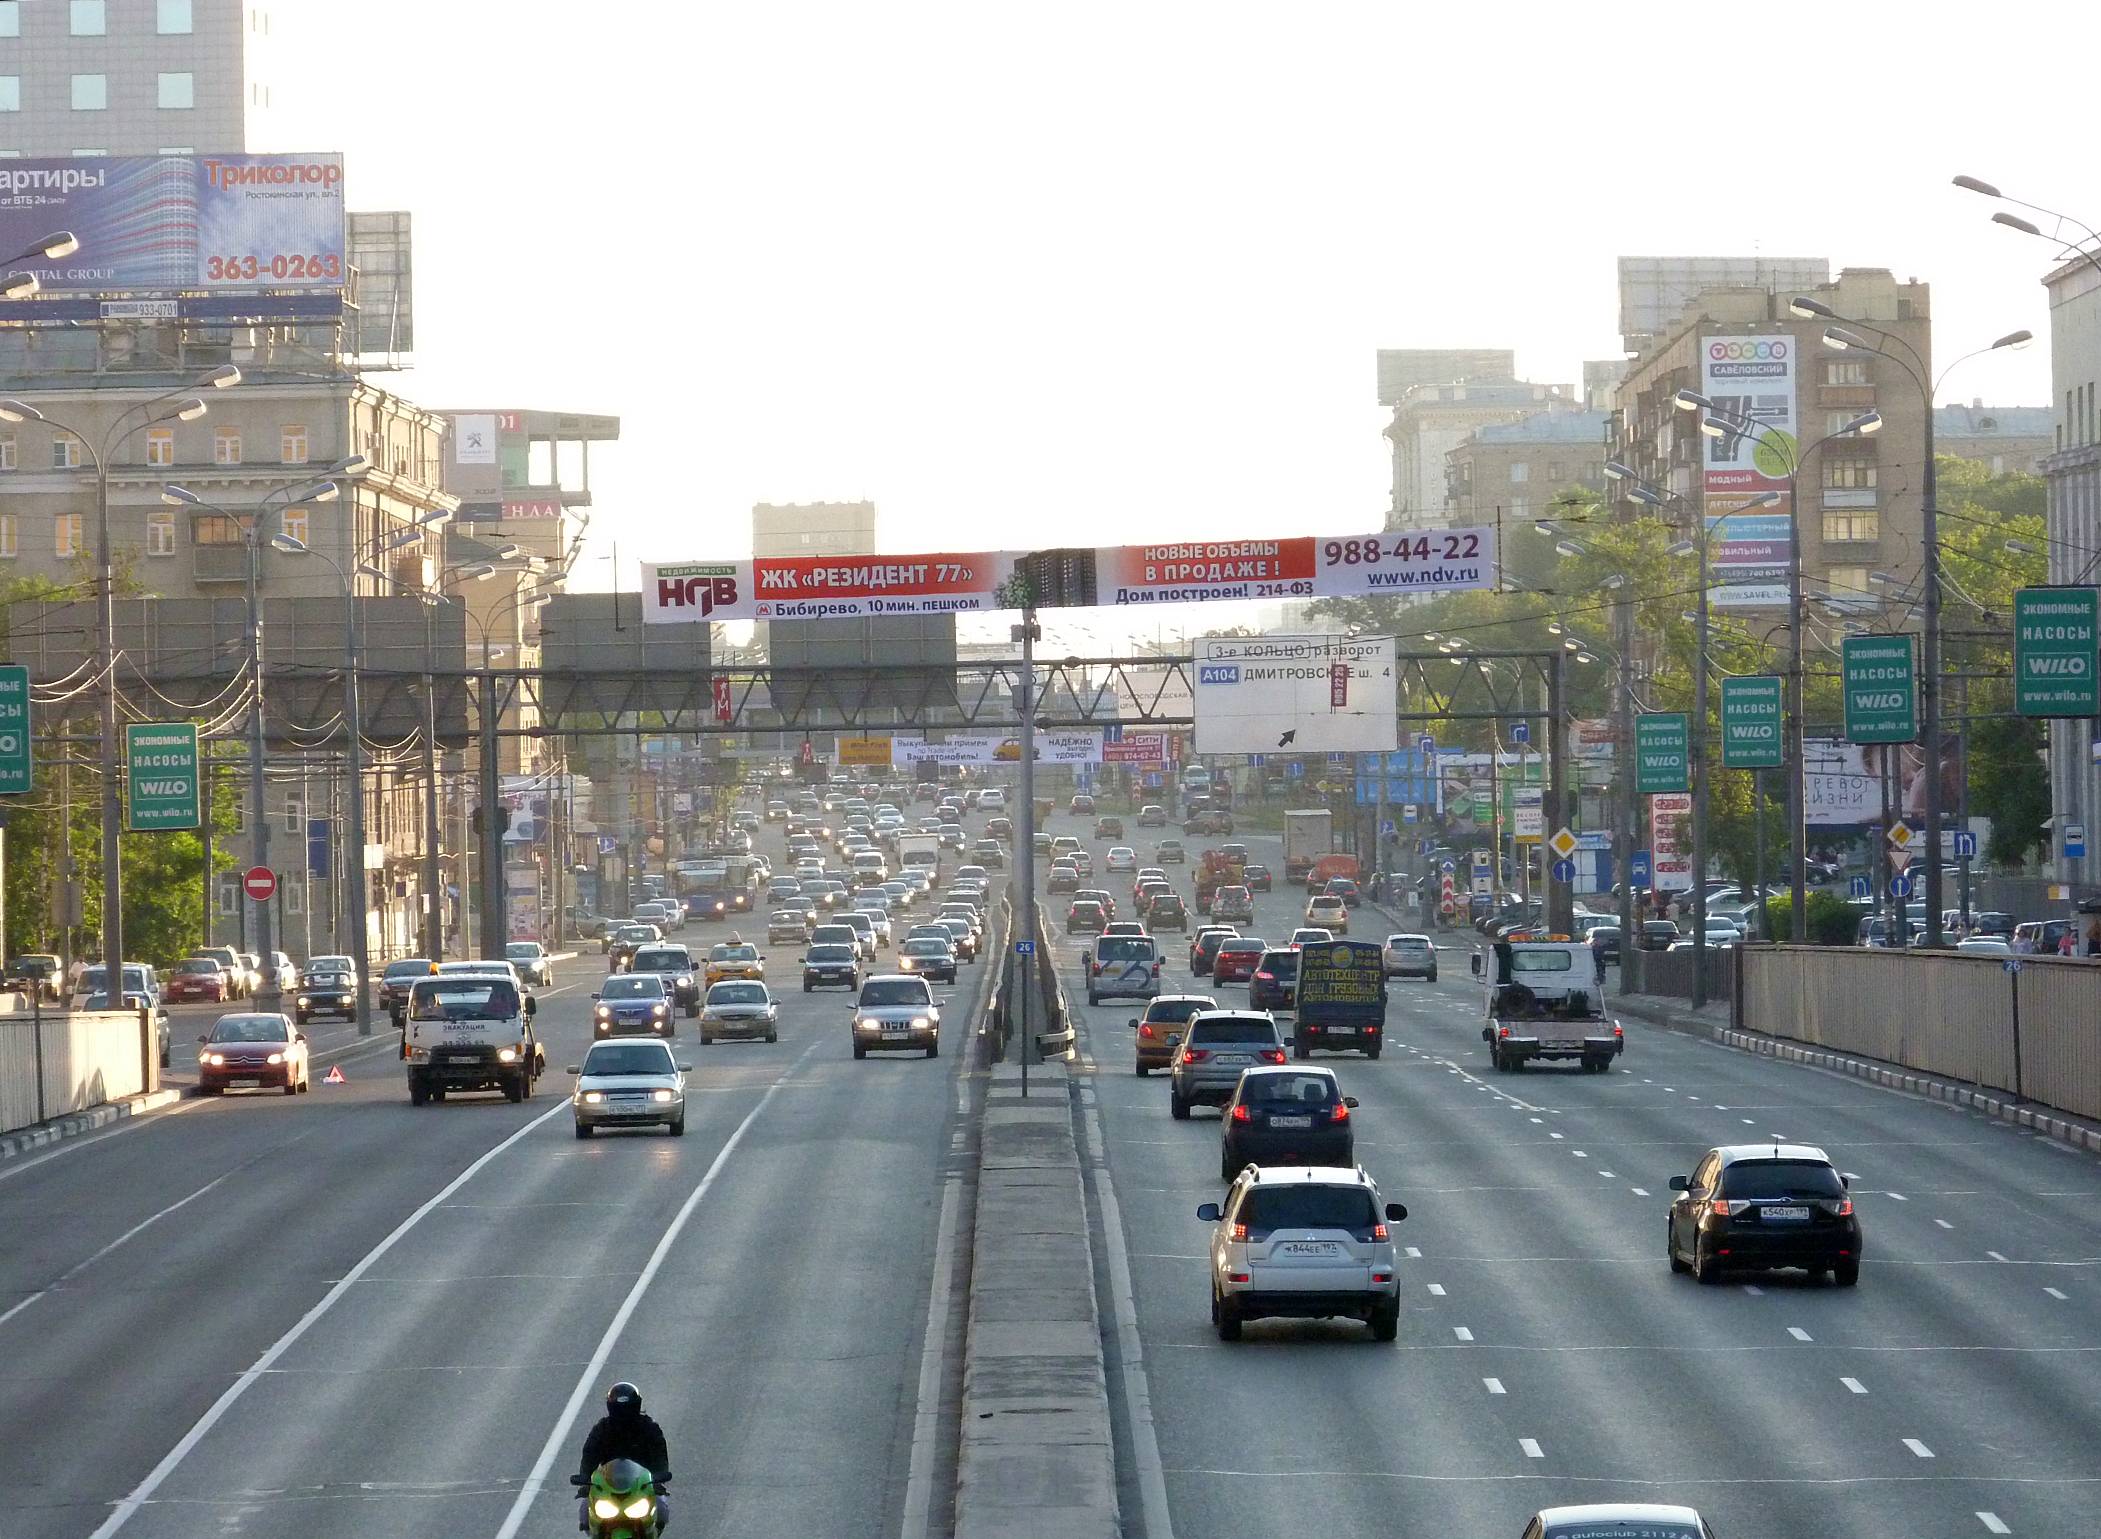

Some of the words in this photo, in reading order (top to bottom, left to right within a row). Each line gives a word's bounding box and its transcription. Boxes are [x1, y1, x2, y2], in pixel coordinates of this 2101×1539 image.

[204, 160, 341, 191] Триколор
[13, 196, 32, 204] ВТБ
[35, 196, 46, 204] 24
[67, 268, 114, 279] GROUP
[208, 255, 341, 280] 363-0263
[139, 303, 178, 316] 933-0701
[1714, 365, 1783, 374] САВЁЛОВСКИЙ
[1709, 474, 1752, 483] МОДНЫЙ
[1145, 544, 1204, 561] НОВЫЕ
[1324, 534, 1480, 567] 988-44-22
[661, 566, 732, 576] НЕДВИЖИМОСТЬ
[761, 568, 798, 589] ЖК
[802, 564, 928, 589] «РЕЗИДЕНТ
[936, 564, 973, 583] 77»
[1145, 566, 1157, 581] В
[1164, 561, 1267, 582] ПРОДАЖЕ
[1367, 566, 1480, 586] www.ndv.ru
[1115, 587, 1154, 605] Дом
[1158, 583, 1249, 603] построен!
[776, 602, 862, 621] Бибирево,
[868, 600, 883, 612] 10
[922, 599, 980, 611] ПЕШКОМ
[2023, 603, 2091, 615] ЭКОНОМНЫЕ
[2023, 626, 2091, 640] НАСОСЫ
[1244, 646, 1305, 659] КОЛЬЦО
[1314, 645, 1382, 658] разворот
[1849, 648, 1907, 660] ЭКОНОМНЫЕ
[2028, 657, 2086, 675] WILO
[1382, 669, 1391, 678] 4
[1850, 667, 1907, 681] НАСОСЫ
[1855, 694, 1904, 708] WILO
[2023, 690, 2092, 701] www.wilo.ru
[1728, 704, 1777, 714] НАСОСЫ
[1732, 726, 1773, 738] WILO
[134, 736, 190, 746] ЭКОНОМНЫЕ
[1641, 737, 1683, 746] НАСОСЫ
[134, 755, 191, 767] НАСОСЫ
[1644, 756, 1680, 767] WILO
[140, 781, 187, 795] WILO
[1020, 943, 1031, 952] 26
[2005, 961, 2021, 971] 26
[1572, 1530, 1637, 1539] autoclub
[1642, 1530, 1677, 1539] 2112
